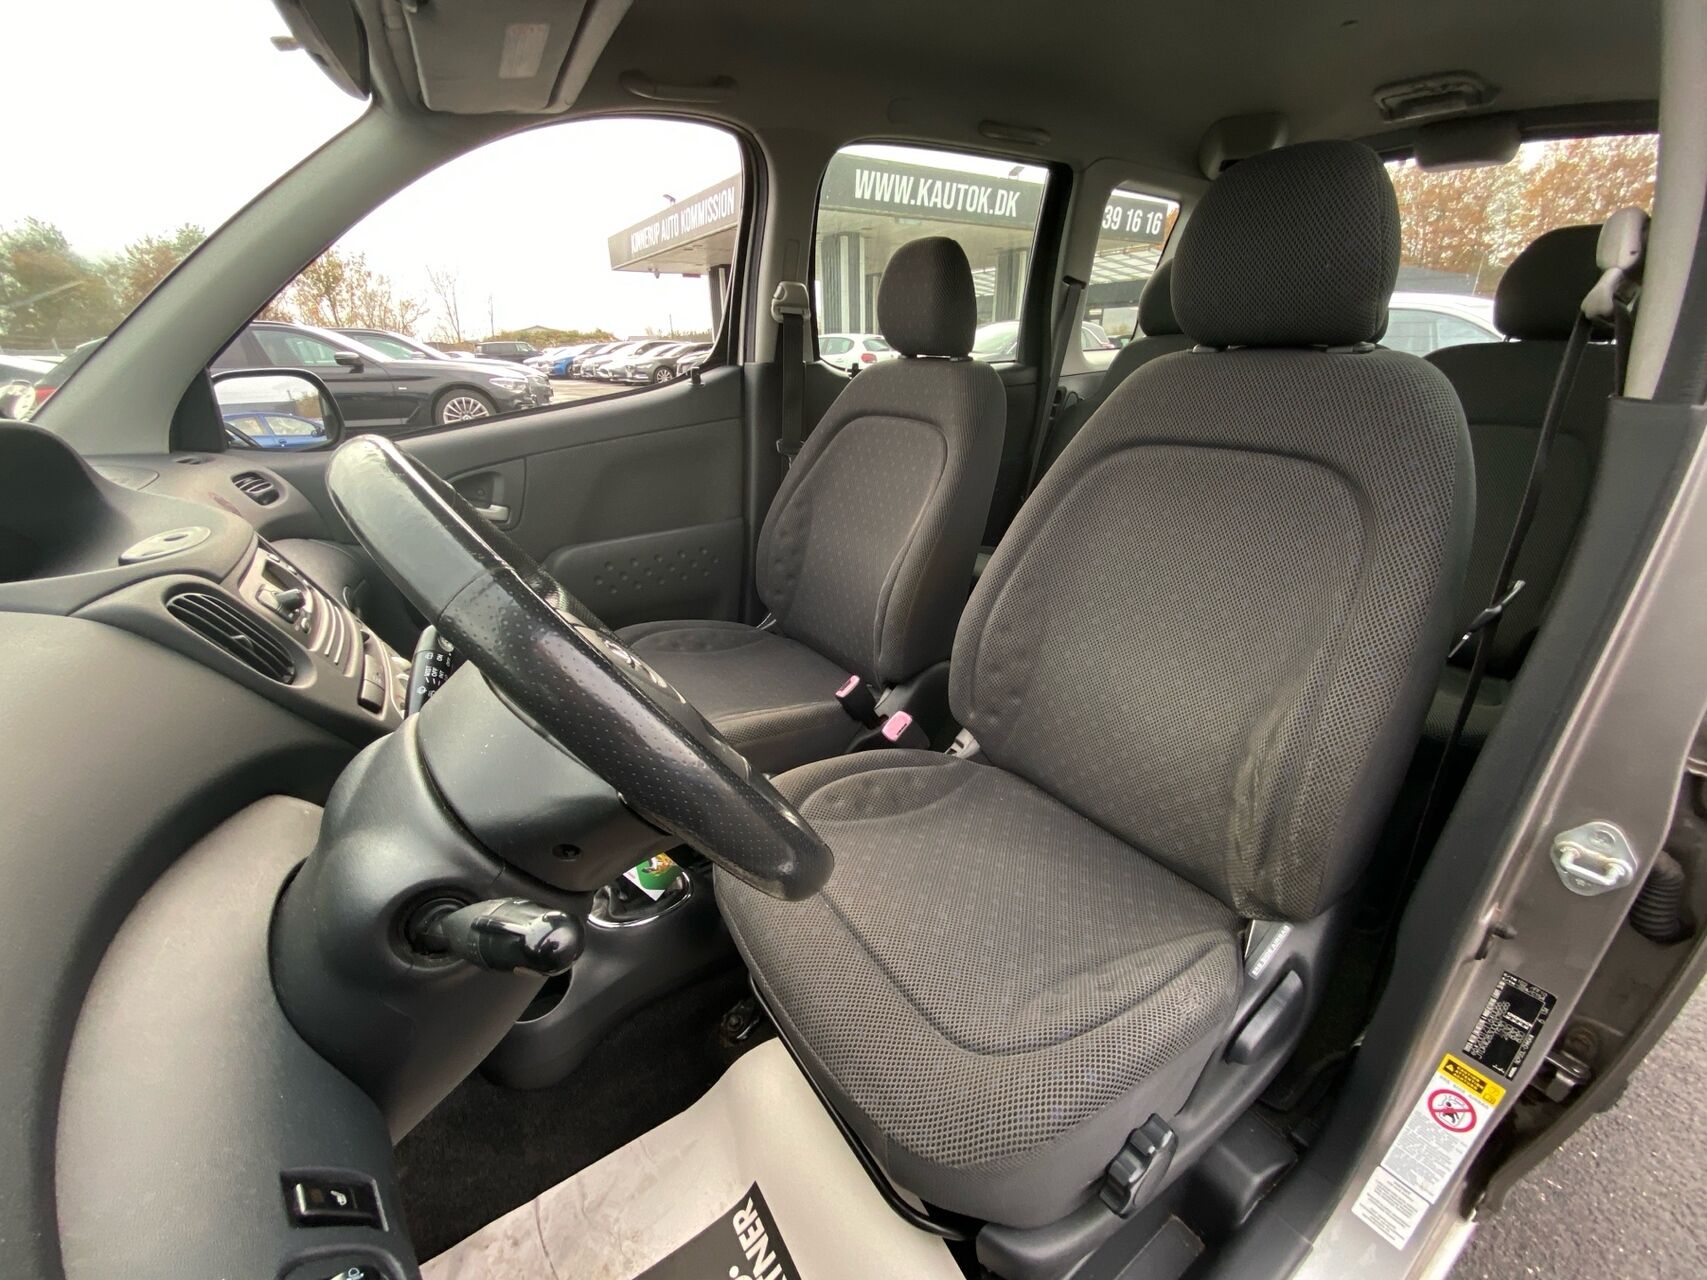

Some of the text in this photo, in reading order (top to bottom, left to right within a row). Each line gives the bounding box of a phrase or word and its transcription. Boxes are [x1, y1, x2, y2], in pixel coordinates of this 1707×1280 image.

[661, 213, 680, 241] AUTO
[680, 187, 735, 234] KOMMISSION
[854, 168, 1021, 217] WWW.KAUTOK.DK
[1102, 204, 1164, 235] 39 16 16
